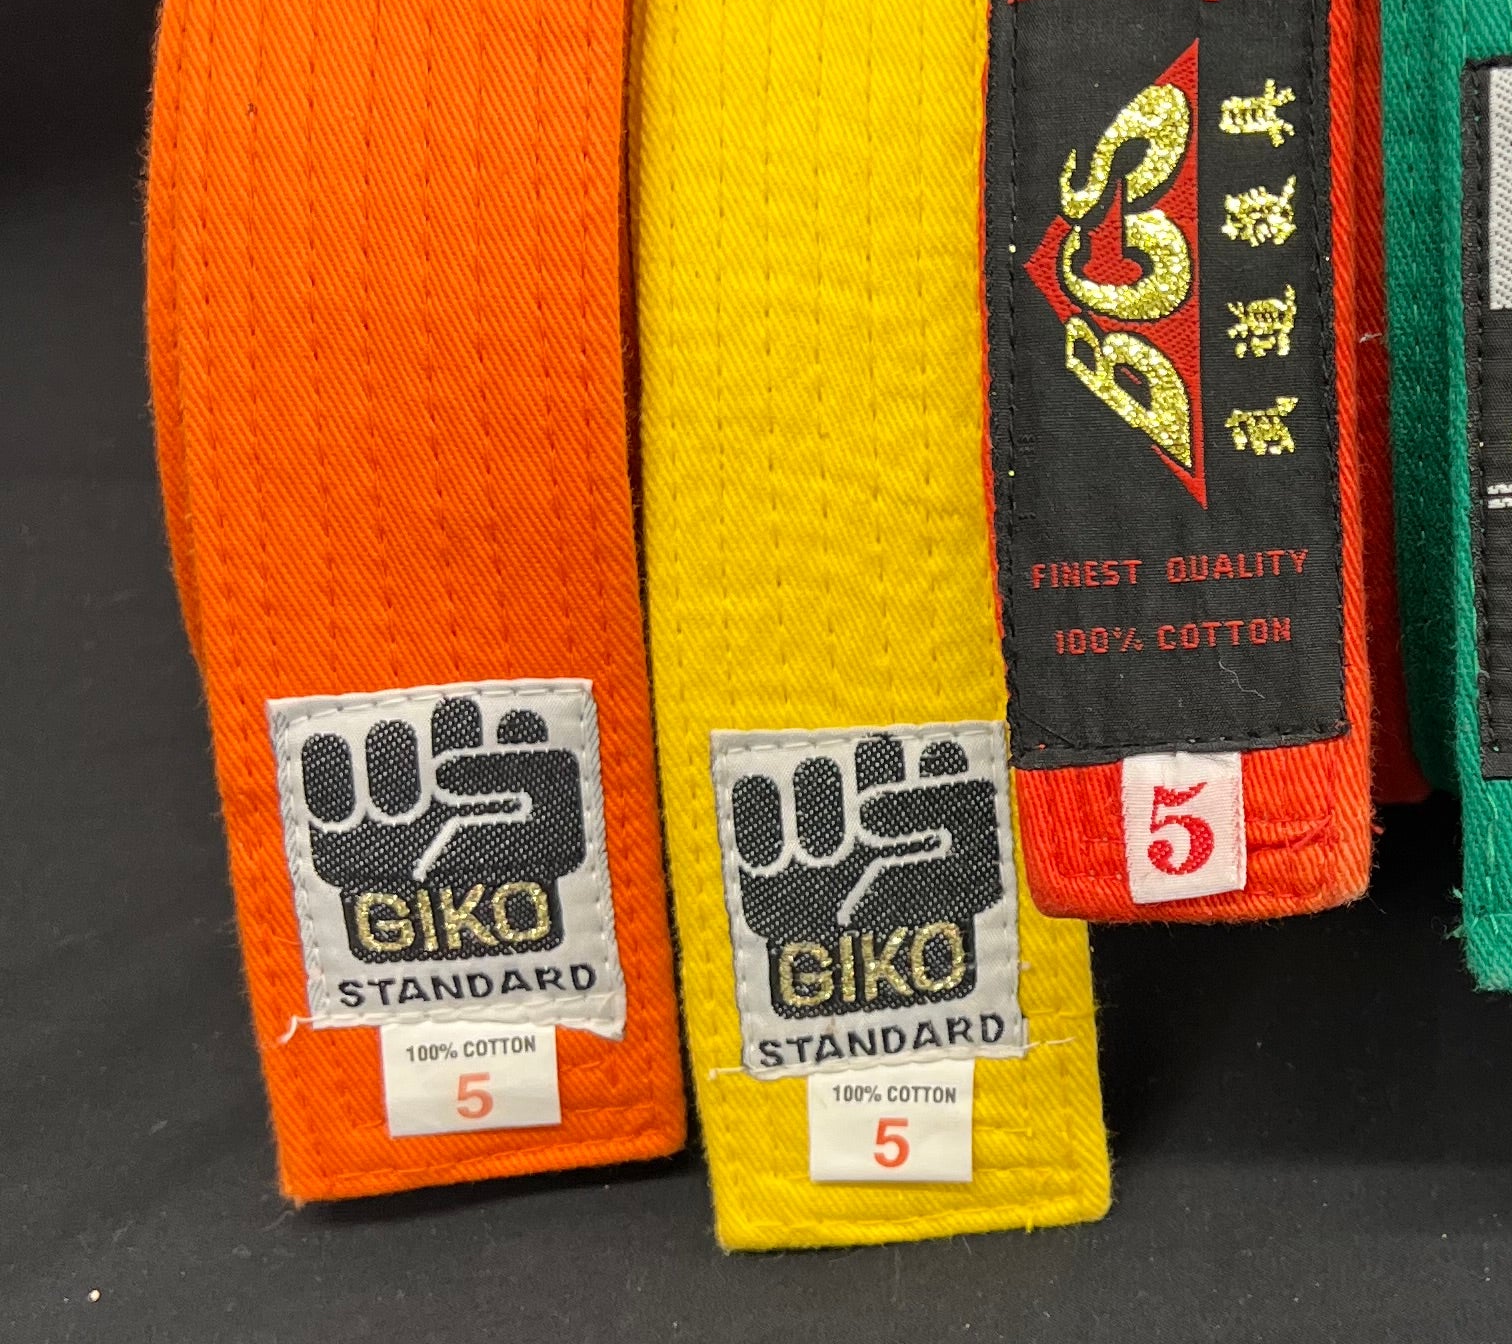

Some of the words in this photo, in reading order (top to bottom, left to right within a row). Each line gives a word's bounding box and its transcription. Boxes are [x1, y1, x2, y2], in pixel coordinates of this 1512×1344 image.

[1031, 559, 1142, 589] FINEST
[1166, 549, 1308, 584] QUALITY
[1055, 626, 1144, 655] 100%
[1156, 617, 1291, 650] COTTON
[1147, 782, 1214, 875] 5
[354, 882, 552, 953] GIKO
[338, 962, 597, 1008] STANDARD
[778, 922, 967, 1008] GIKO
[406, 1041, 458, 1063] 100%
[463, 1035, 536, 1059] COTTON
[758, 1013, 1006, 1068] STANDARD
[456, 1072, 494, 1119] 5
[833, 1084, 882, 1103] 100%
[887, 1085, 957, 1104] COTTON
[873, 1117, 910, 1168] 5
